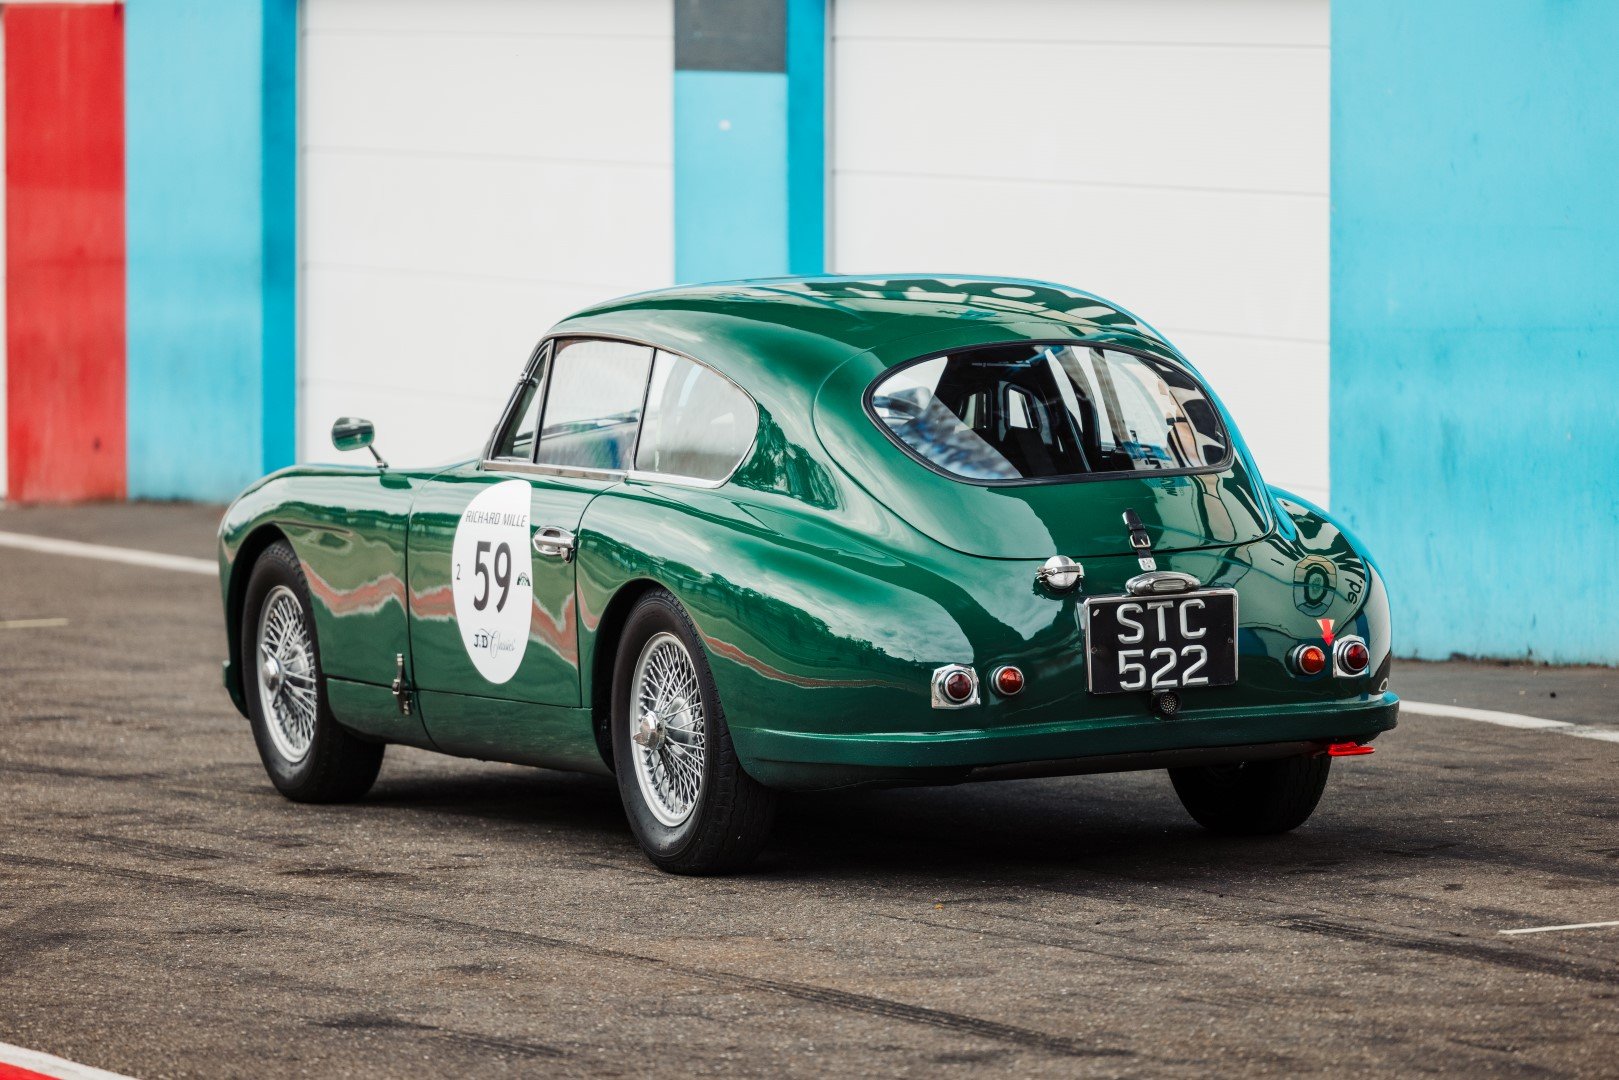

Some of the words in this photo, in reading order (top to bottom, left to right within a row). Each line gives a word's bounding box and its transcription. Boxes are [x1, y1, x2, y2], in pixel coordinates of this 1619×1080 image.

[465, 510, 501, 525] RICHARD
[502, 513, 527, 528] MILLE
[456, 563, 461, 580] 2
[473, 541, 511, 613] 59
[1116, 598, 1207, 645] STC
[1117, 644, 1209, 691] 522
